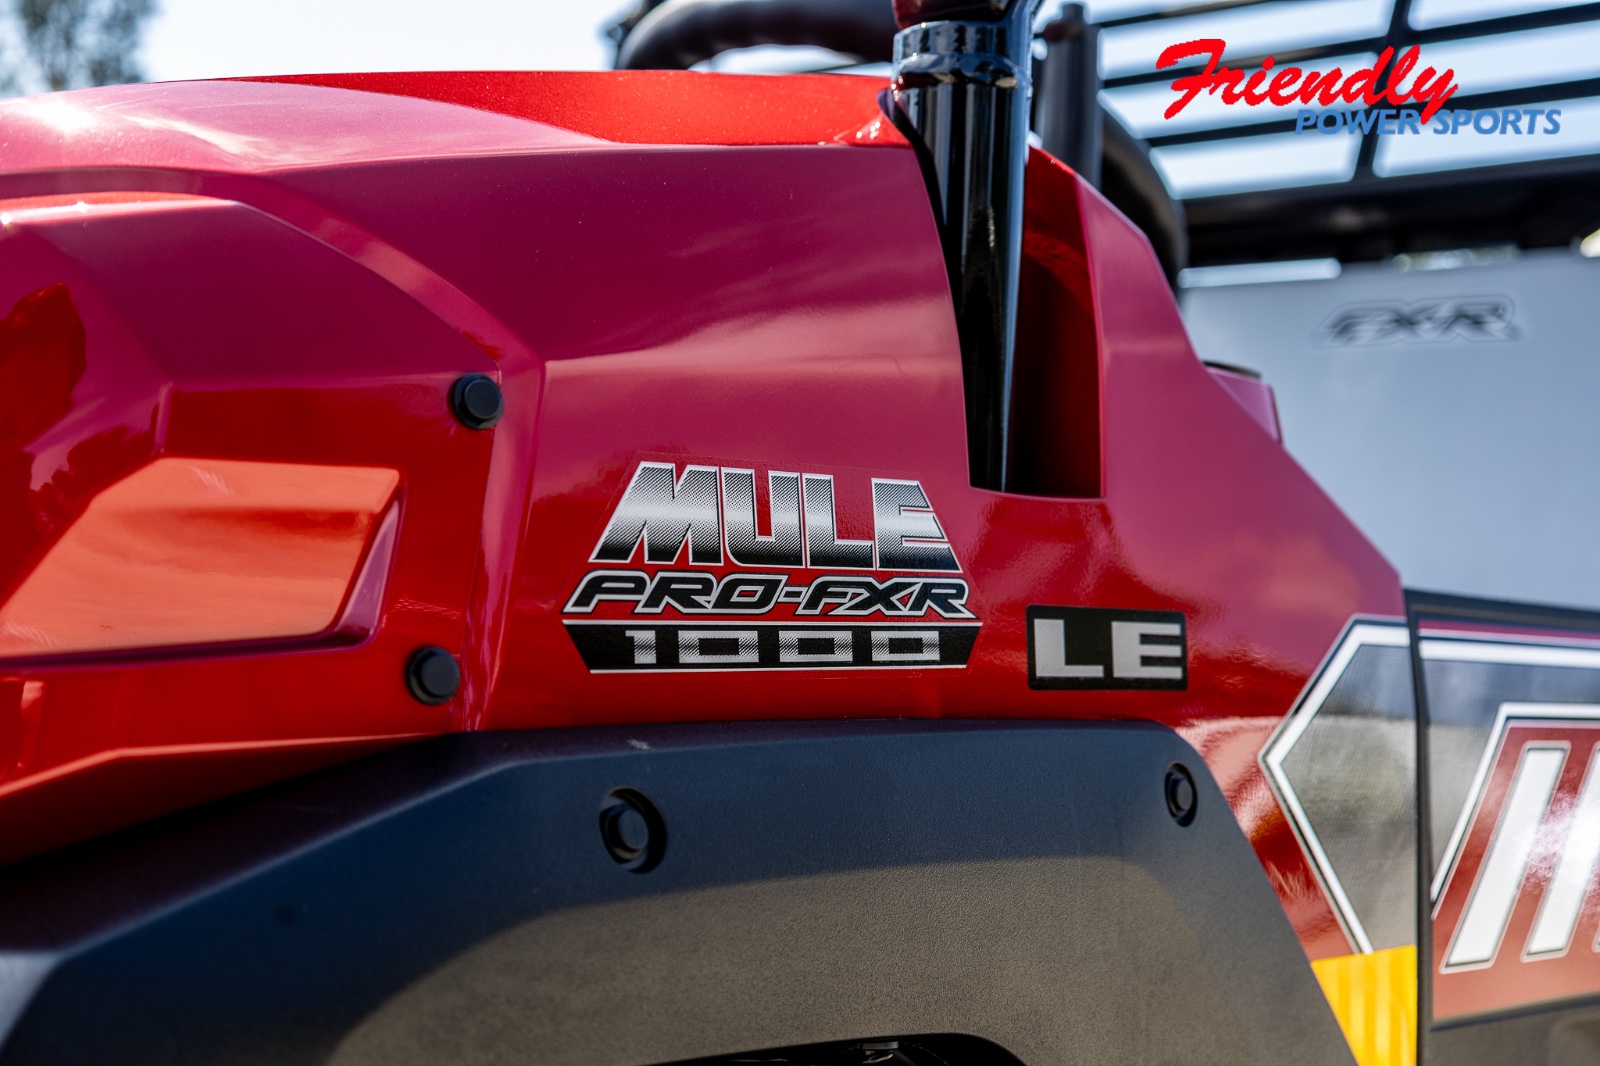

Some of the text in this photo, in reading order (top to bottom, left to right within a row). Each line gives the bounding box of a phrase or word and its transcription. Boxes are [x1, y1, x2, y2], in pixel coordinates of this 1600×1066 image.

[1316, 296, 1523, 346] FXR
[588, 461, 963, 572] MULE
[561, 570, 979, 620] PRO-FXR
[625, 629, 941, 665] 1000
[1034, 618, 1184, 679] LE
